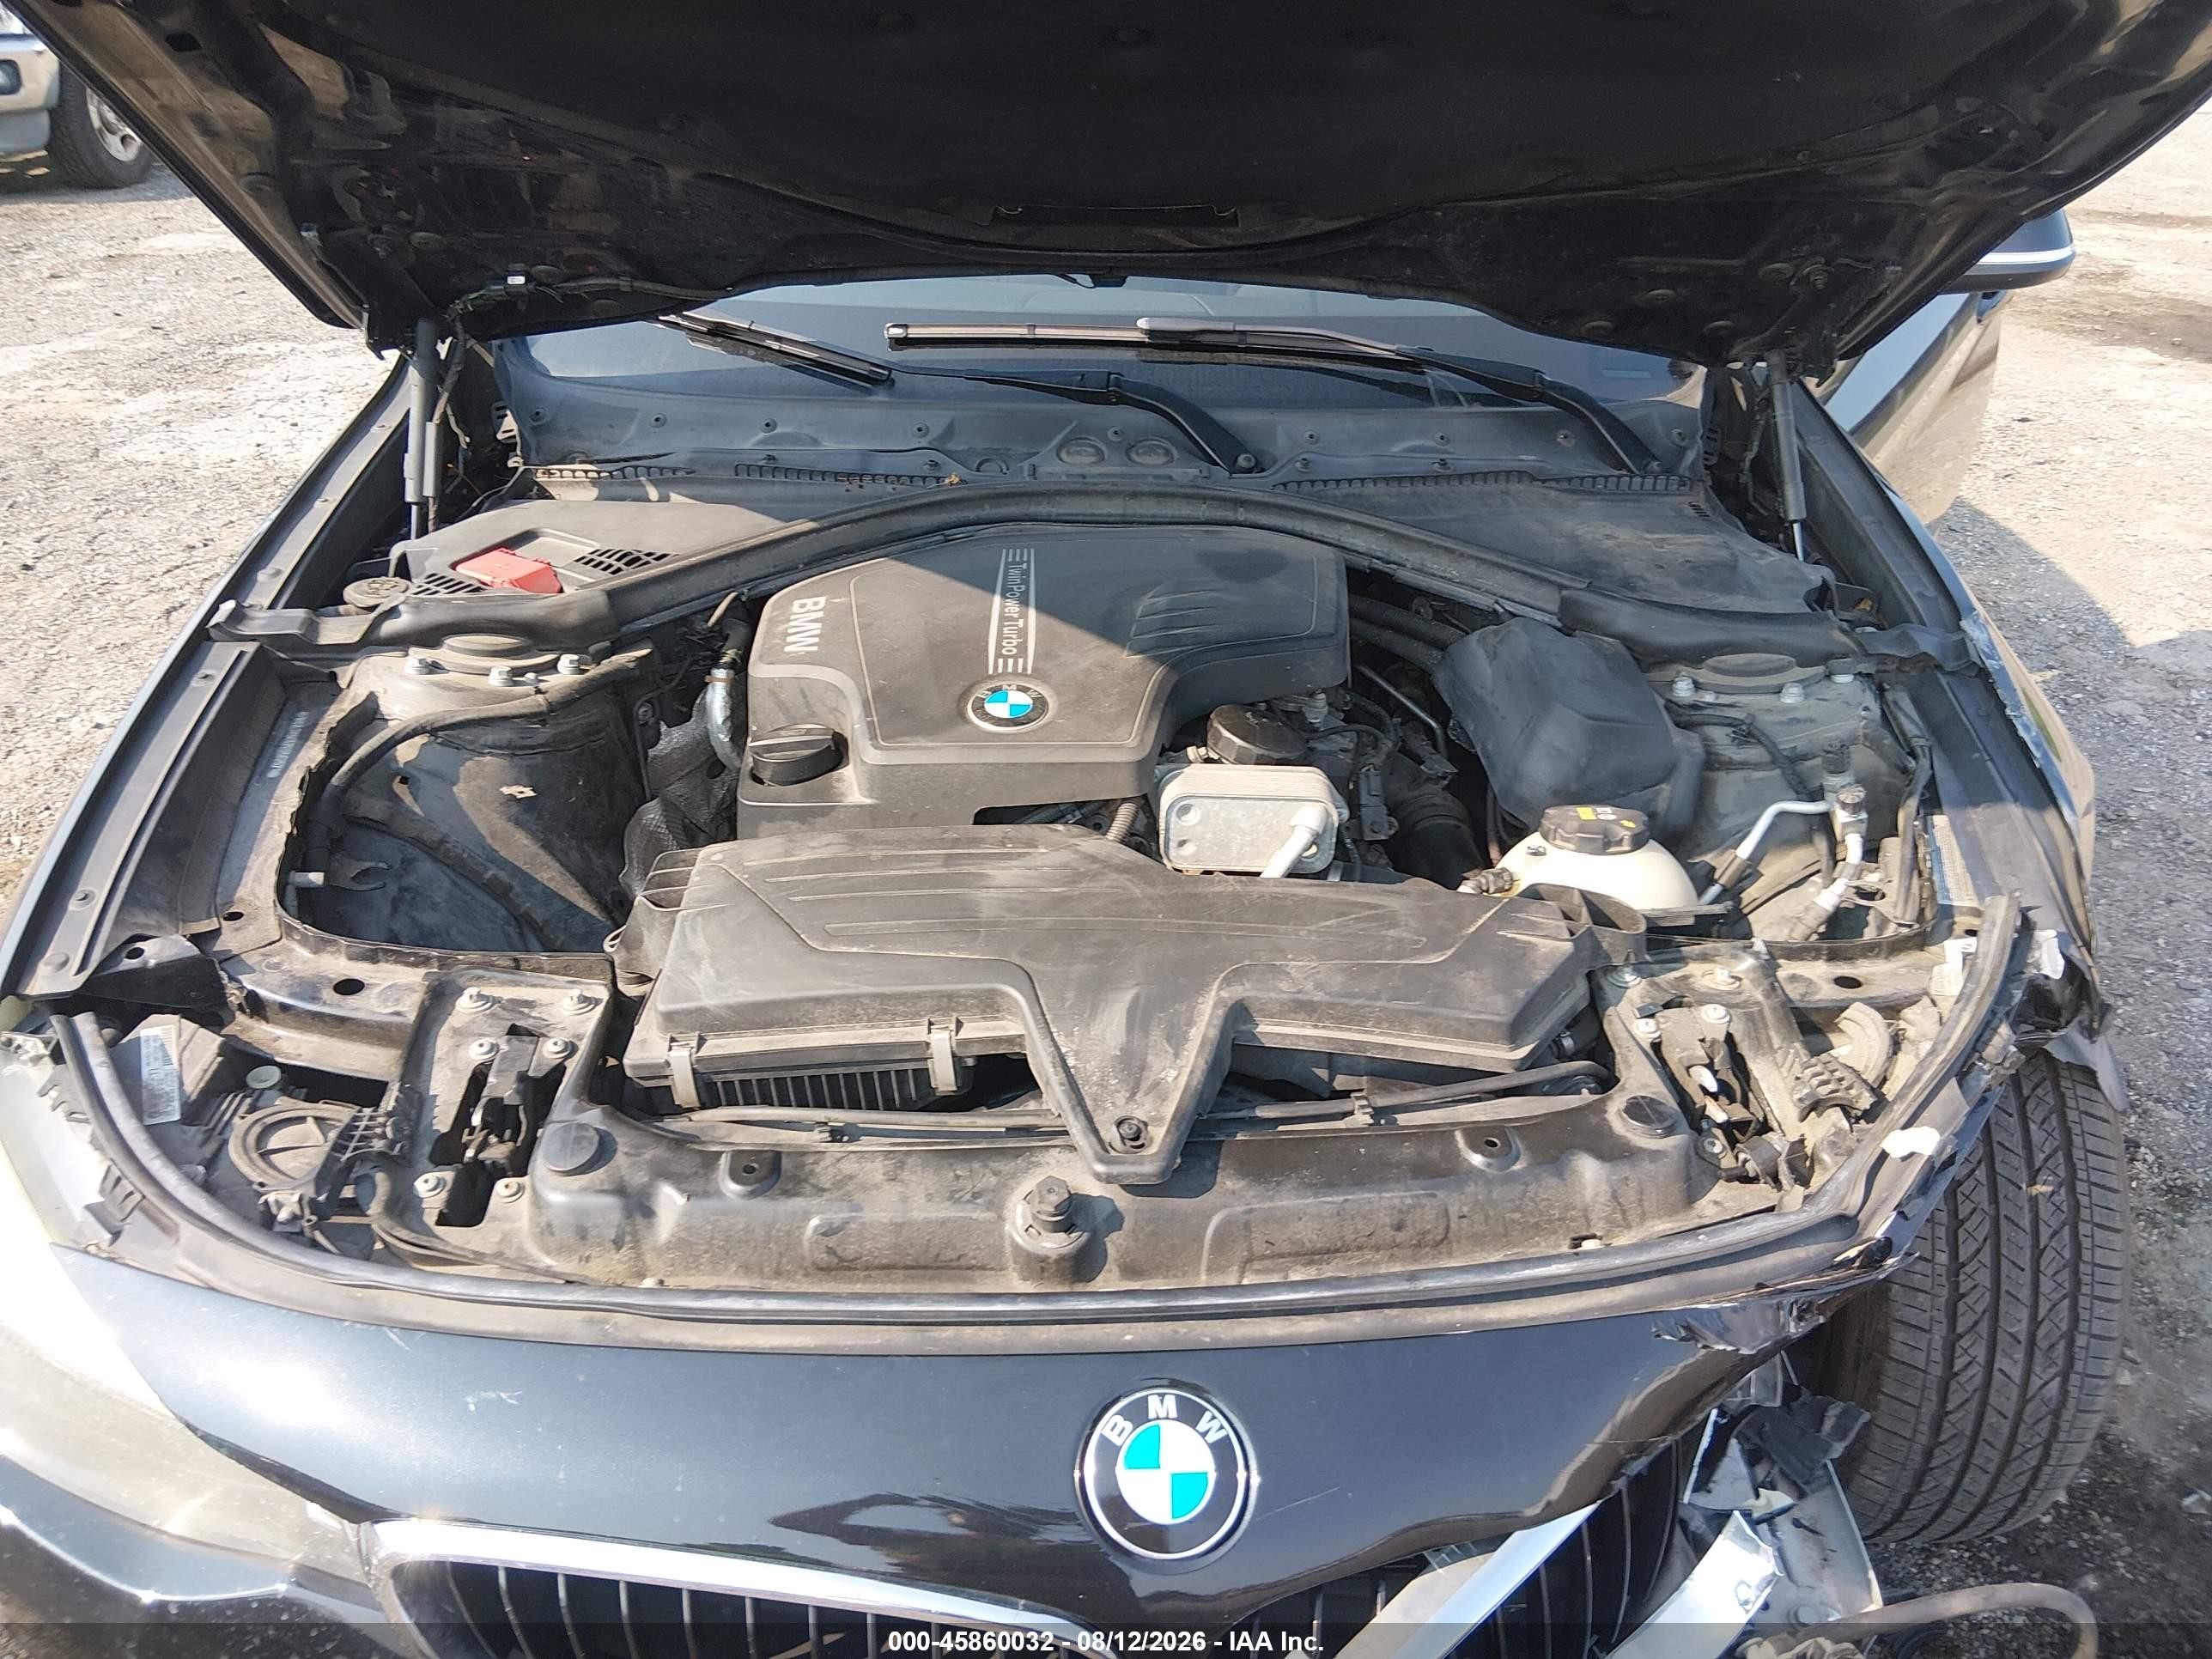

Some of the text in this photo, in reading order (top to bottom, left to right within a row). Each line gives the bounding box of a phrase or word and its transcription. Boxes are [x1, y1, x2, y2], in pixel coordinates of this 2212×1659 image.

[784, 596, 826, 653] BMW
[1001, 562, 1027, 655] TwinPower Turbo
[1100, 1394, 1228, 1447] BMW
